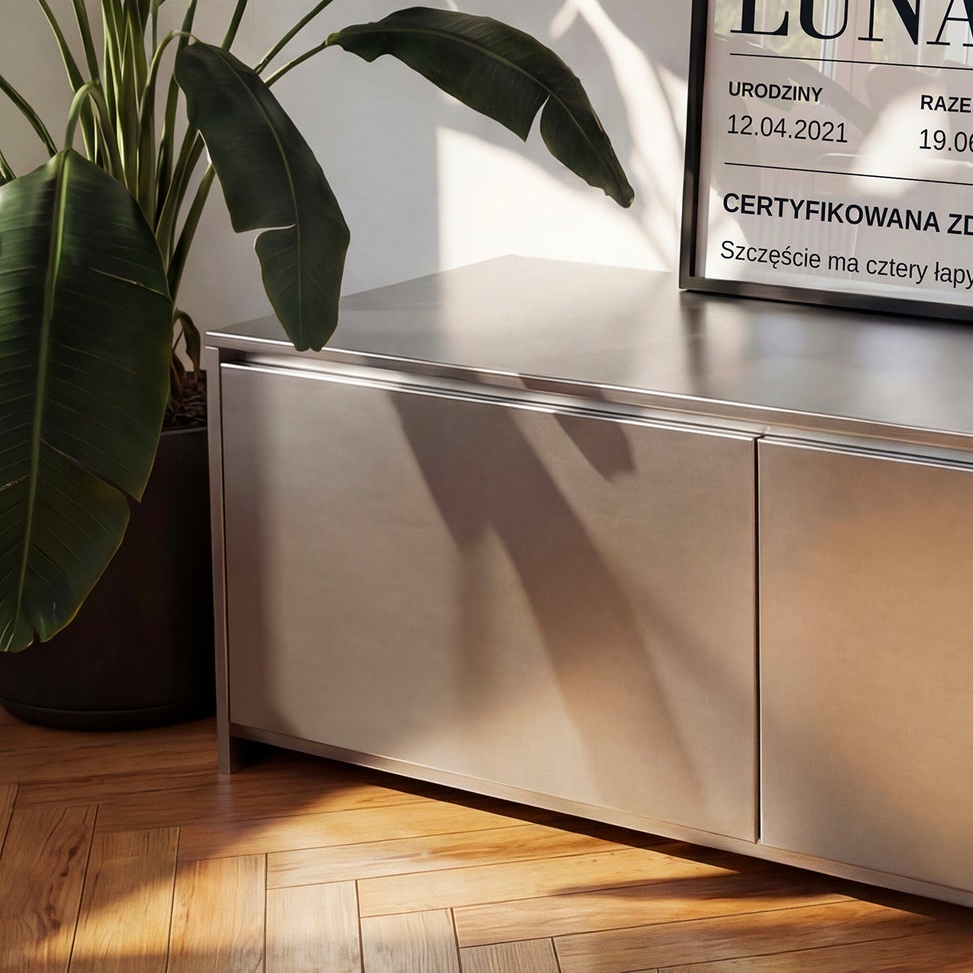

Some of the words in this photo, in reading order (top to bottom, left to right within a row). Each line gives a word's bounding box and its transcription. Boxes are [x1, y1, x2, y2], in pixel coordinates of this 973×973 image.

[729, 80, 824, 103] URODZINY
[727, 113, 849, 144] 12.04.2021
[722, 192, 940, 233] CERTYFIKOWANA
[720, 239, 821, 270] Szczęście
[827, 254, 861, 274] ma
[865, 258, 929, 285] cztery
